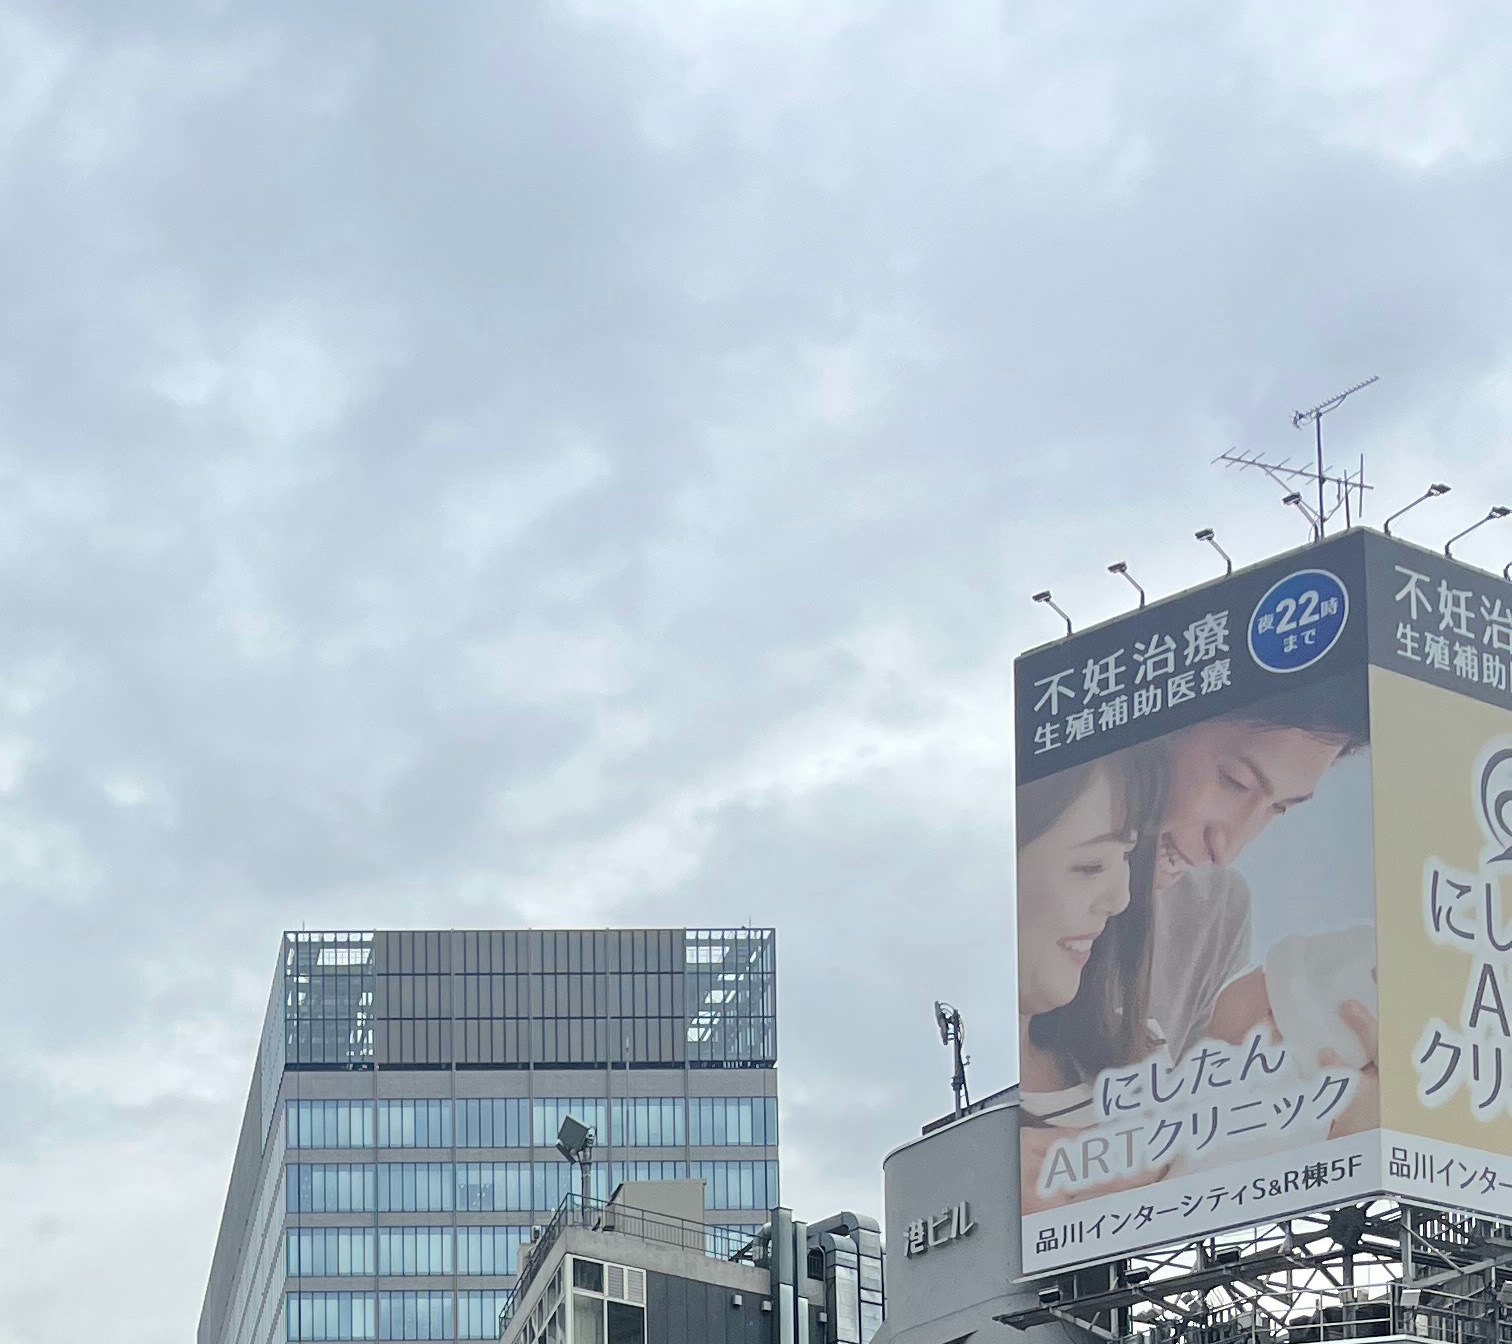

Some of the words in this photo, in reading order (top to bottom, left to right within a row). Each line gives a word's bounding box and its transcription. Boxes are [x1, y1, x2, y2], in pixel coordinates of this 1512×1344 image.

[1258, 590, 1338, 635] 夜22時
[1284, 629, 1316, 652] まで
[1034, 610, 1229, 715] 不妊治療
[1397, 622, 1512, 693] 生殖補助
[1034, 659, 1232, 755] 生殖補助医療
[1469, 963, 1511, 1037] A
[1102, 1034, 1286, 1115] にしたん
[1420, 1031, 1502, 1109] クリ
[1044, 1076, 1351, 1189] ARTクリニック
[1036, 1153, 1363, 1253] 品川インターシティS&R棟5F
